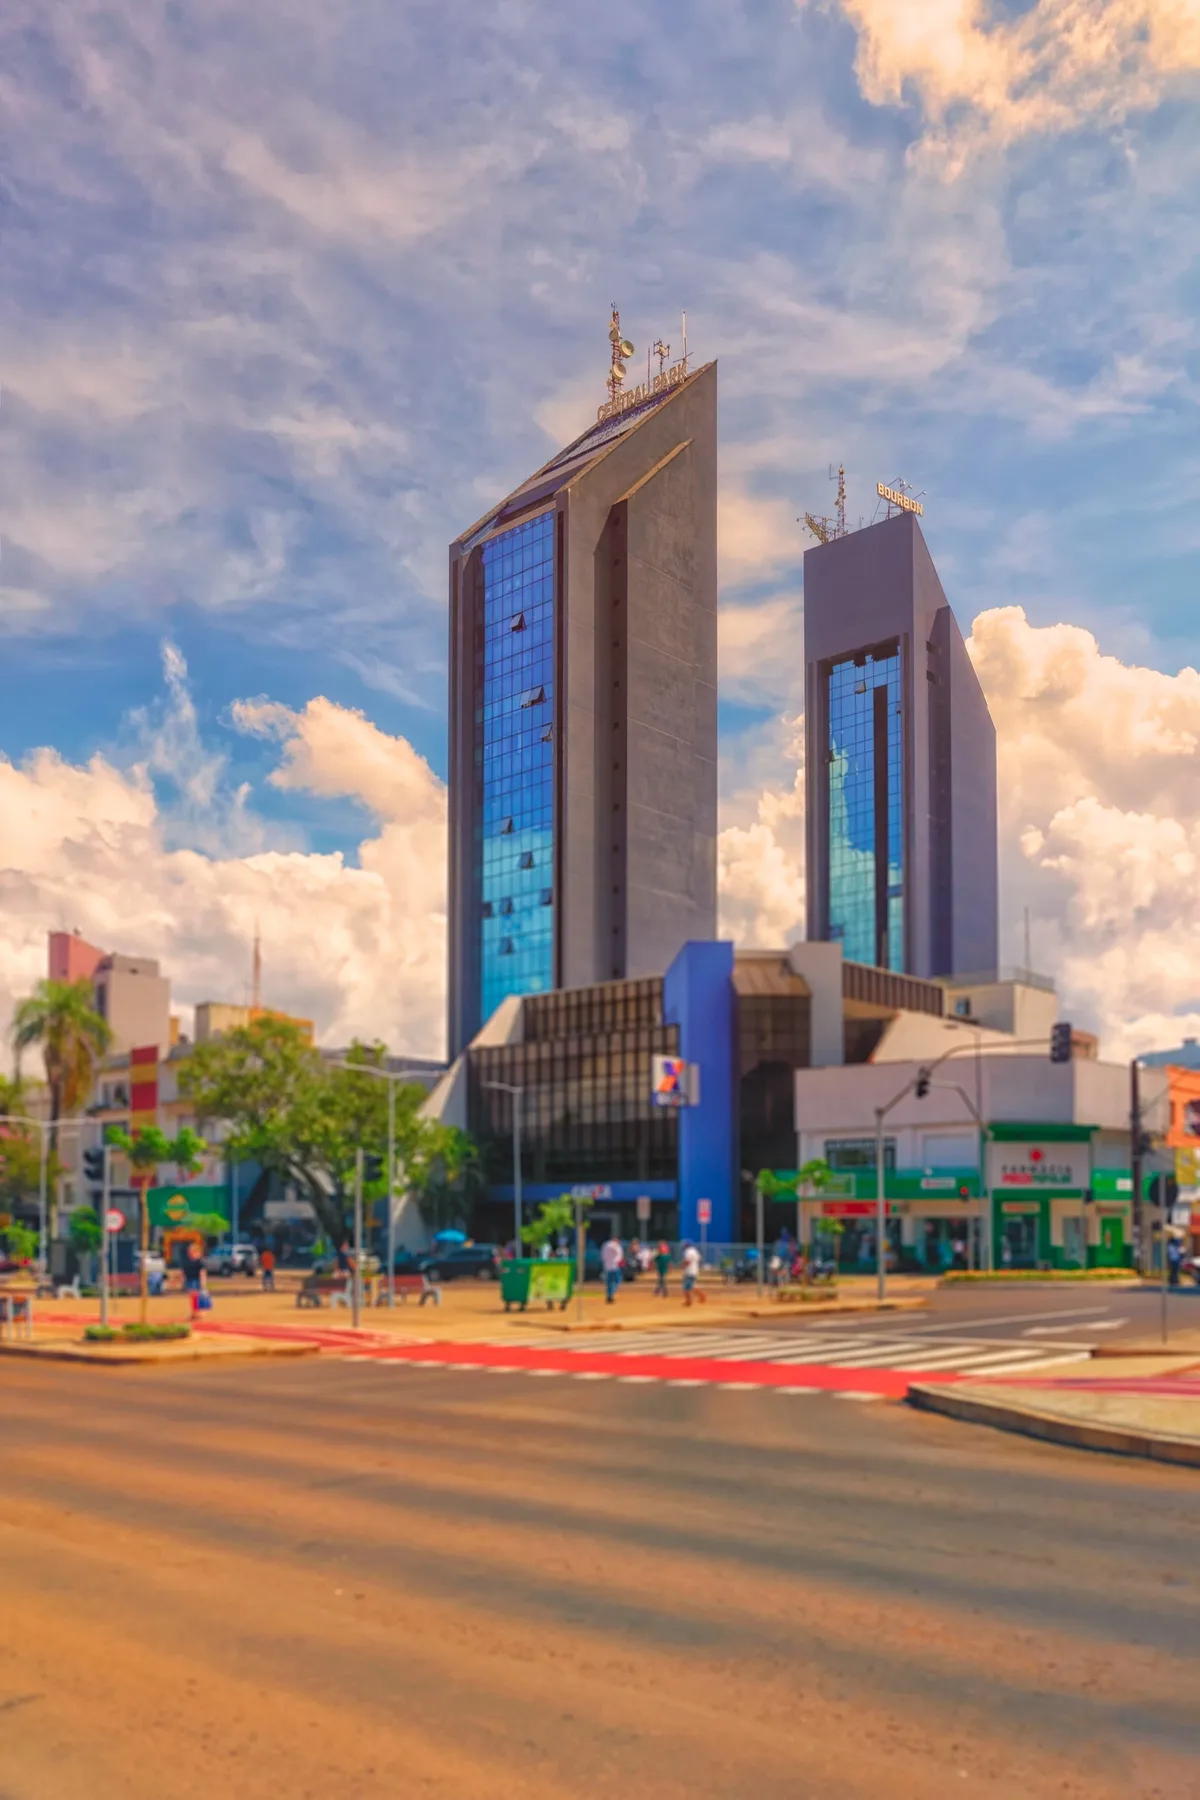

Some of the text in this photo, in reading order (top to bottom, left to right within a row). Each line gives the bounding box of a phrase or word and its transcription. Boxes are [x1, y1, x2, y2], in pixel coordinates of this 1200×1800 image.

[597, 363, 688, 421] CENTRAL PARK
[877, 482, 924, 517] BOURBON
